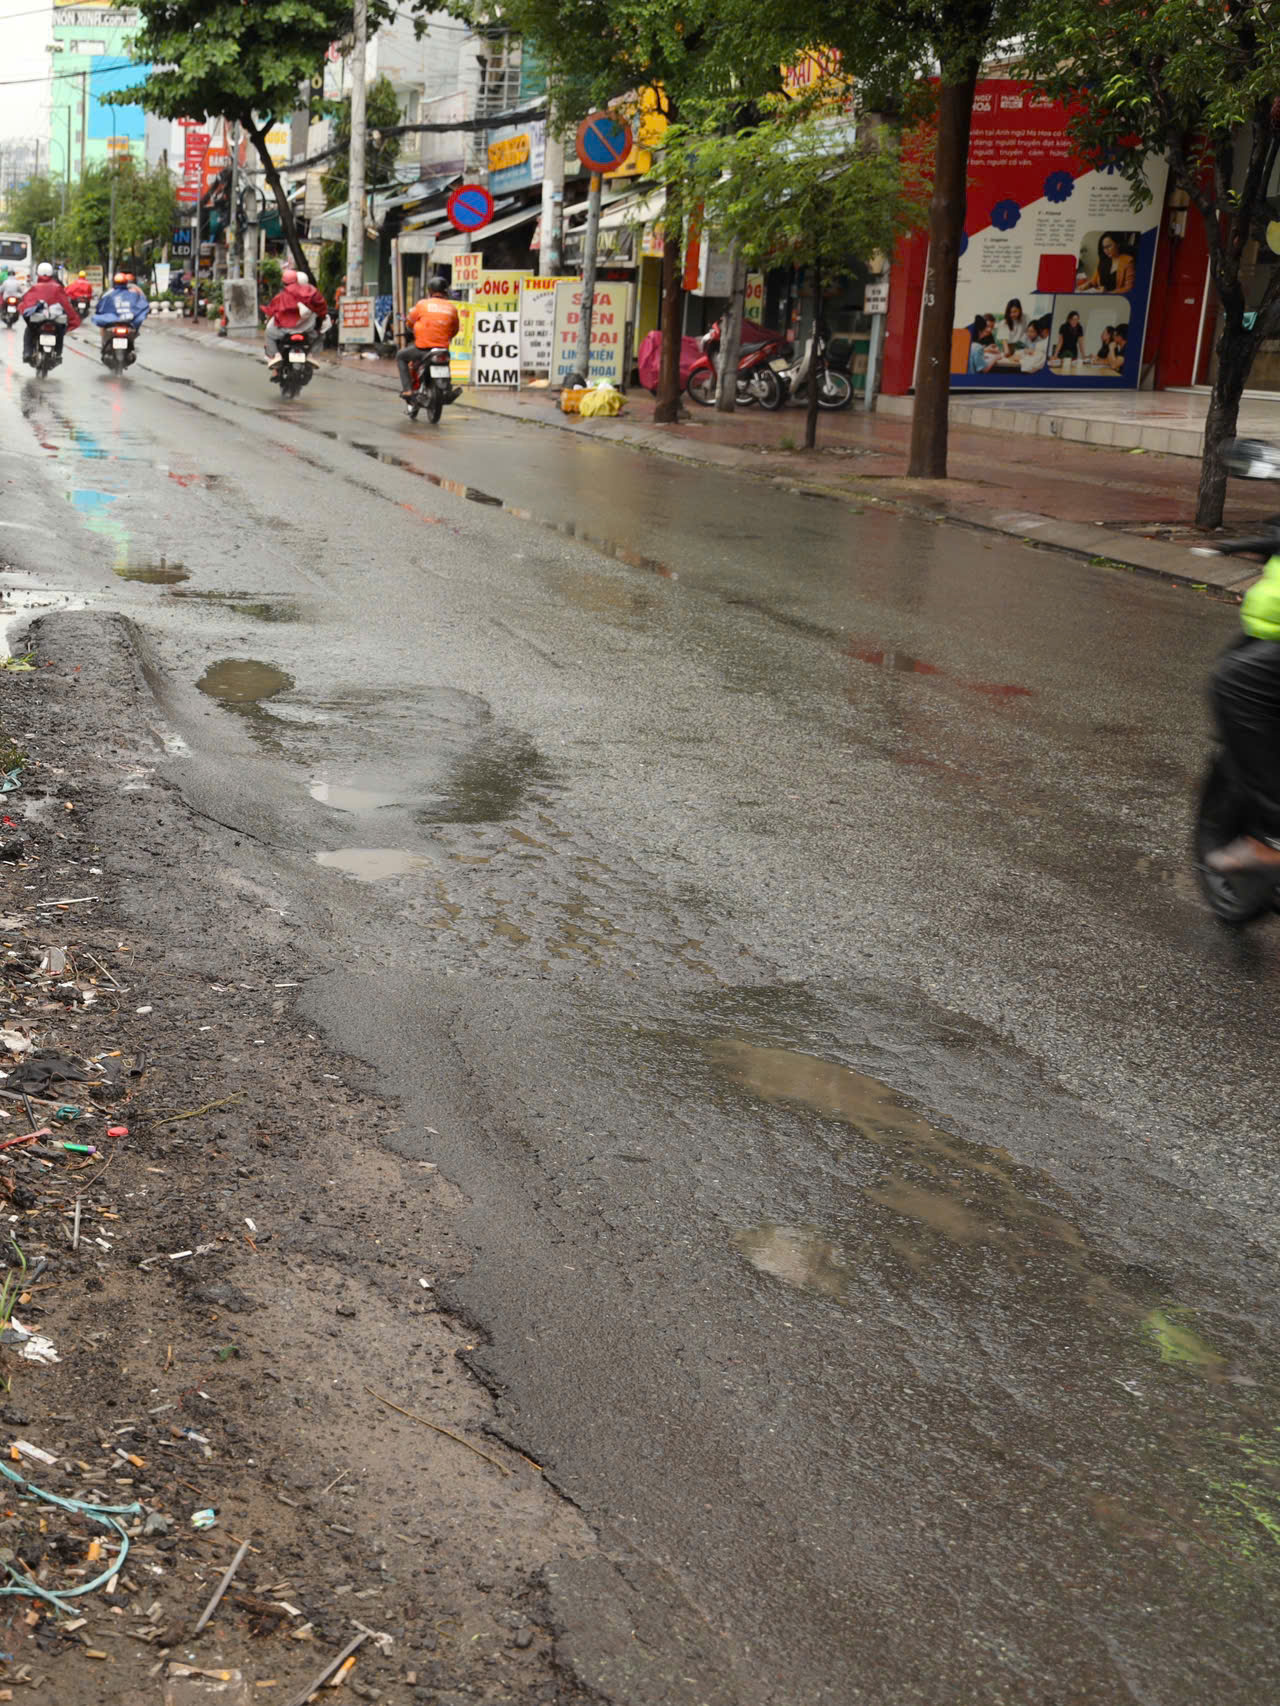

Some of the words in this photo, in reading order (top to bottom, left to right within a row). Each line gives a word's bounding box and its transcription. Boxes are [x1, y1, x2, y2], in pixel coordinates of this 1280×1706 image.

[172, 245, 190, 256] LED
[477, 314, 518, 333] CẮT
[477, 341, 519, 358] TÓC
[477, 369, 519, 384] NAM
